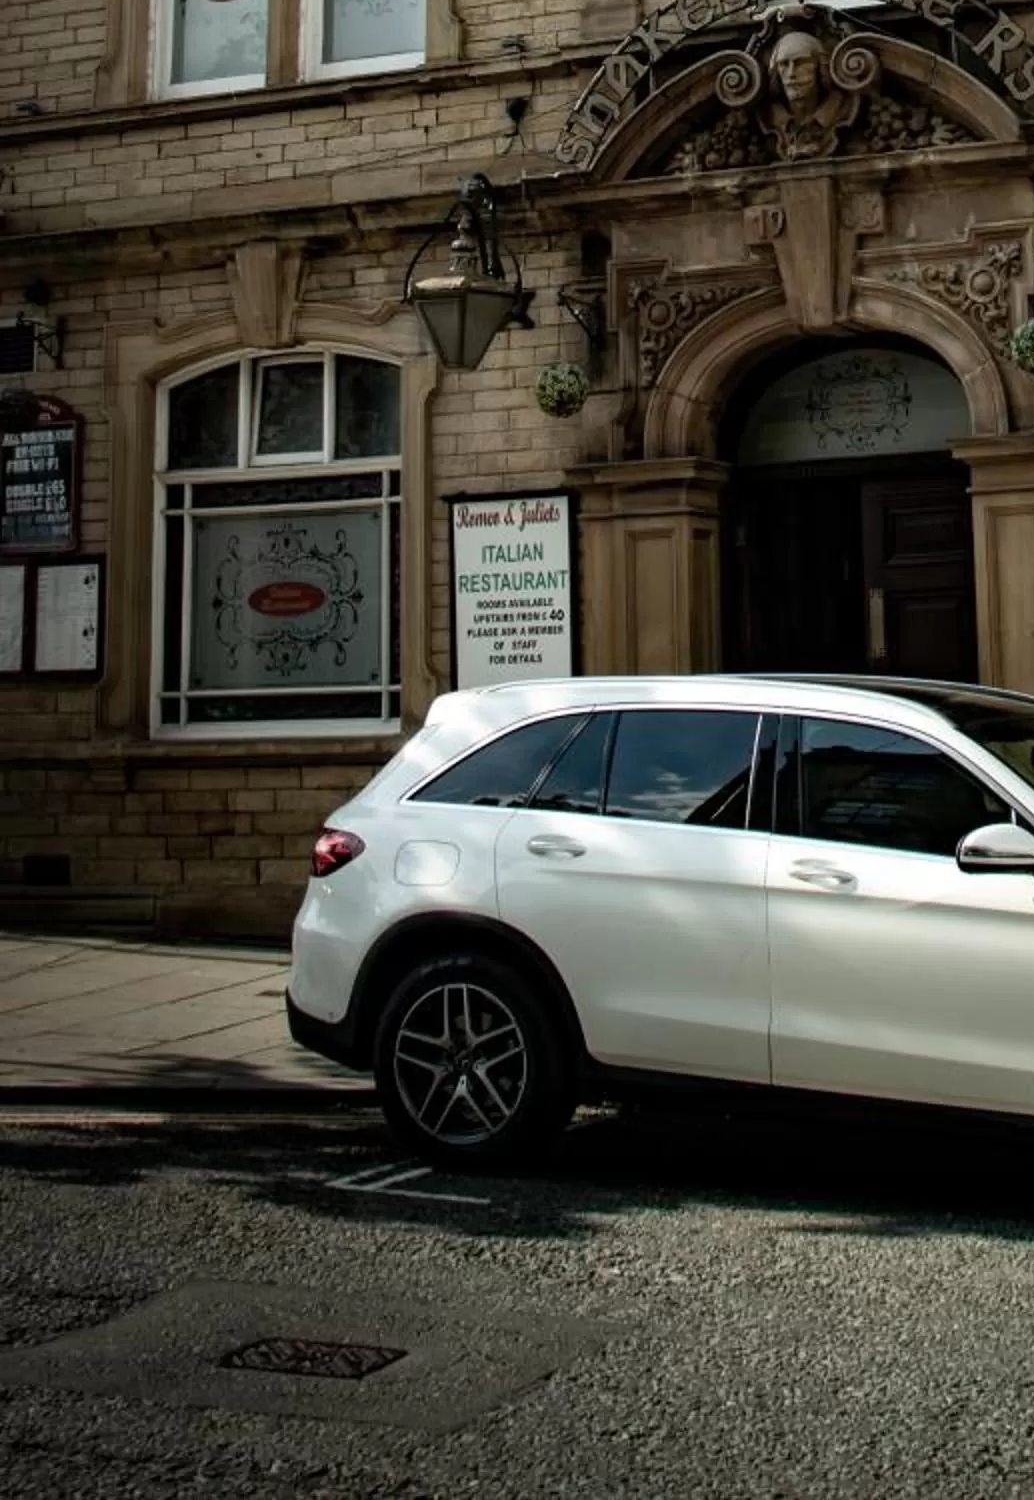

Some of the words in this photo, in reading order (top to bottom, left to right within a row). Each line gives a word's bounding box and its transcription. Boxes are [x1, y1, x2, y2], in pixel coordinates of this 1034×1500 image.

[503, 504, 516, 527] &
[481, 541, 544, 564] ITALIAN
[459, 570, 568, 593] RESTAURANT
[477, 599, 507, 609] ROOMS
[508, 597, 554, 608] AVAILABLE
[473, 612, 514, 624] UPSTAIRS
[516, 611, 541, 622] FROM
[549, 609, 565, 621] 40
[467, 627, 498, 638] PLEASE
[501, 626, 517, 637] ASK
[519, 625, 526, 636] A
[528, 624, 564, 636] MEMBER
[493, 640, 505, 651] OF
[511, 638, 537, 650] STAFF
[489, 653, 506, 665] FOR
[507, 652, 543, 664] DETAILS
